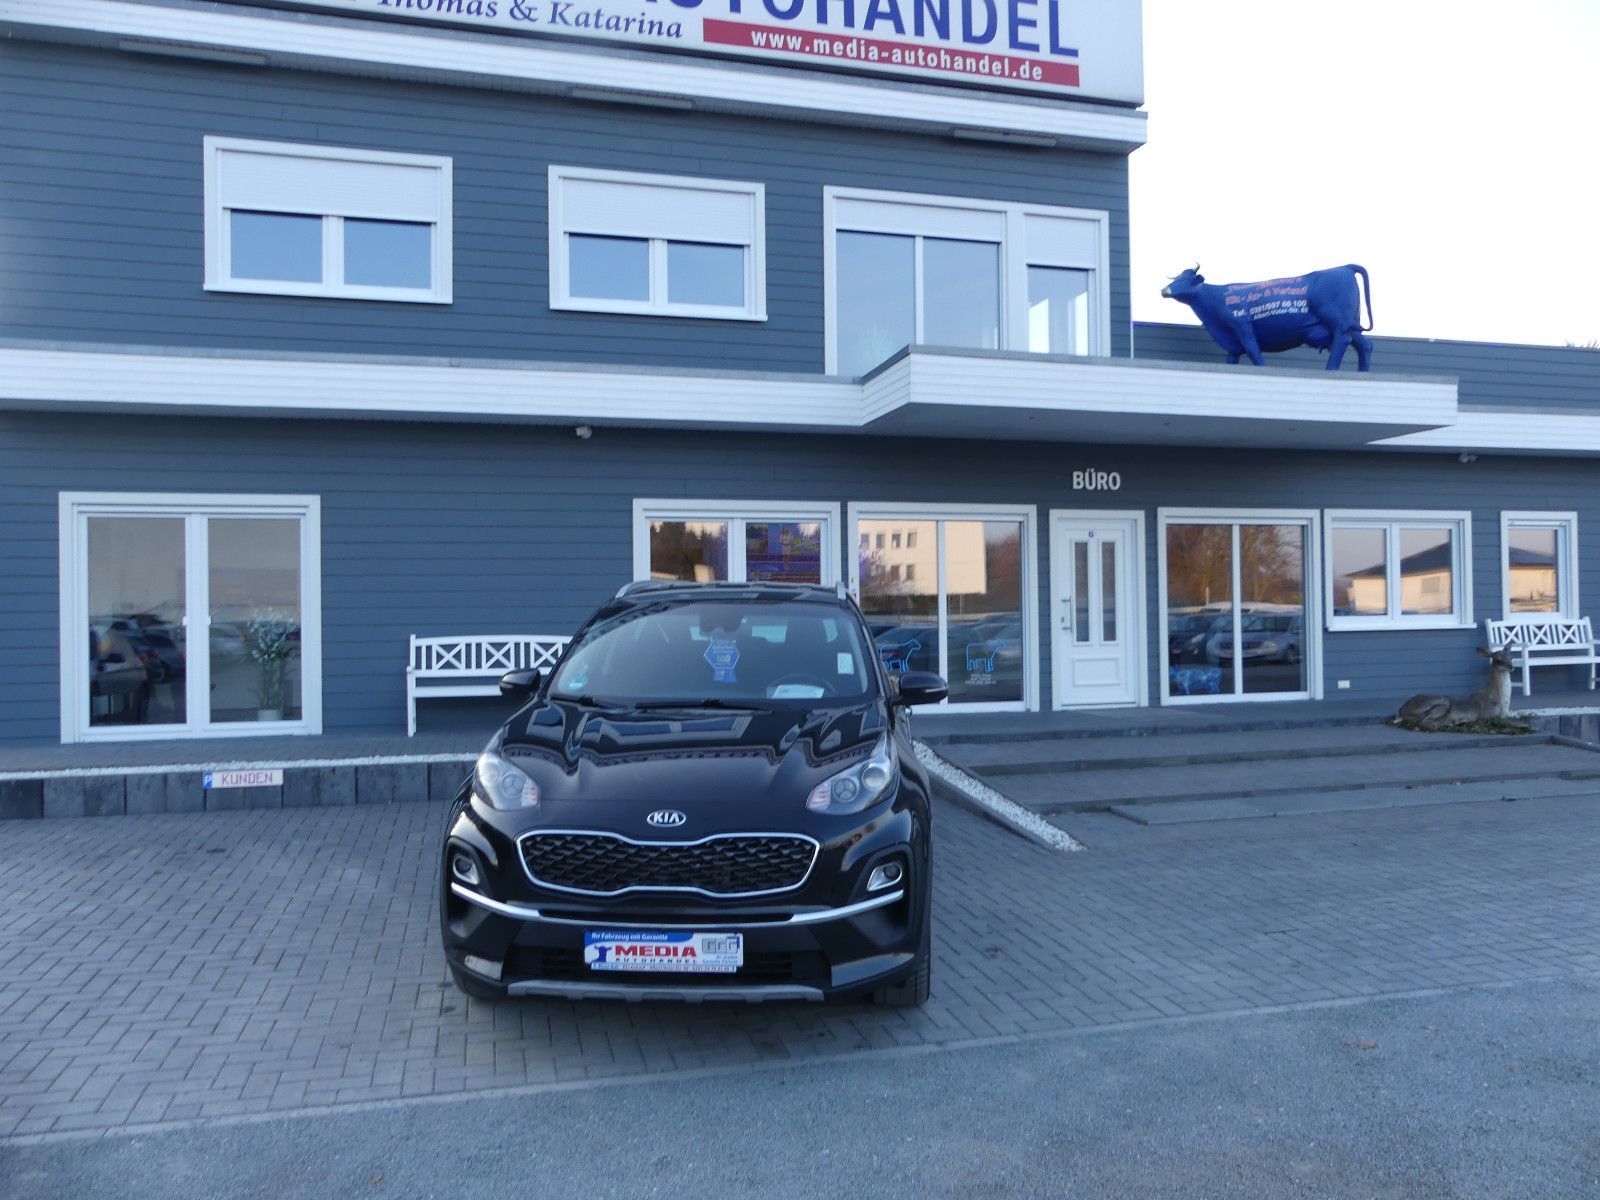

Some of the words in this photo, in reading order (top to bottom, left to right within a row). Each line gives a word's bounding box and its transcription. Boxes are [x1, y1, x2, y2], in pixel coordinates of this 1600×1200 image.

[377, 0, 499, 17] omas
[508, 0, 539, 22] &
[548, 2, 683, 38] Katarina
[645, 0, 1079, 58] ANDEL
[750, 30, 1043, 81] www.media-autohandel.de
[1232, 308, 1247, 317] Tel.
[1072, 467, 1121, 491] BÜRO
[221, 771, 273, 785] KUNDEN
[601, 932, 629, 942] Fahrzeug
[641, 933, 668, 942] Garantie
[615, 945, 697, 957] MEDIA
